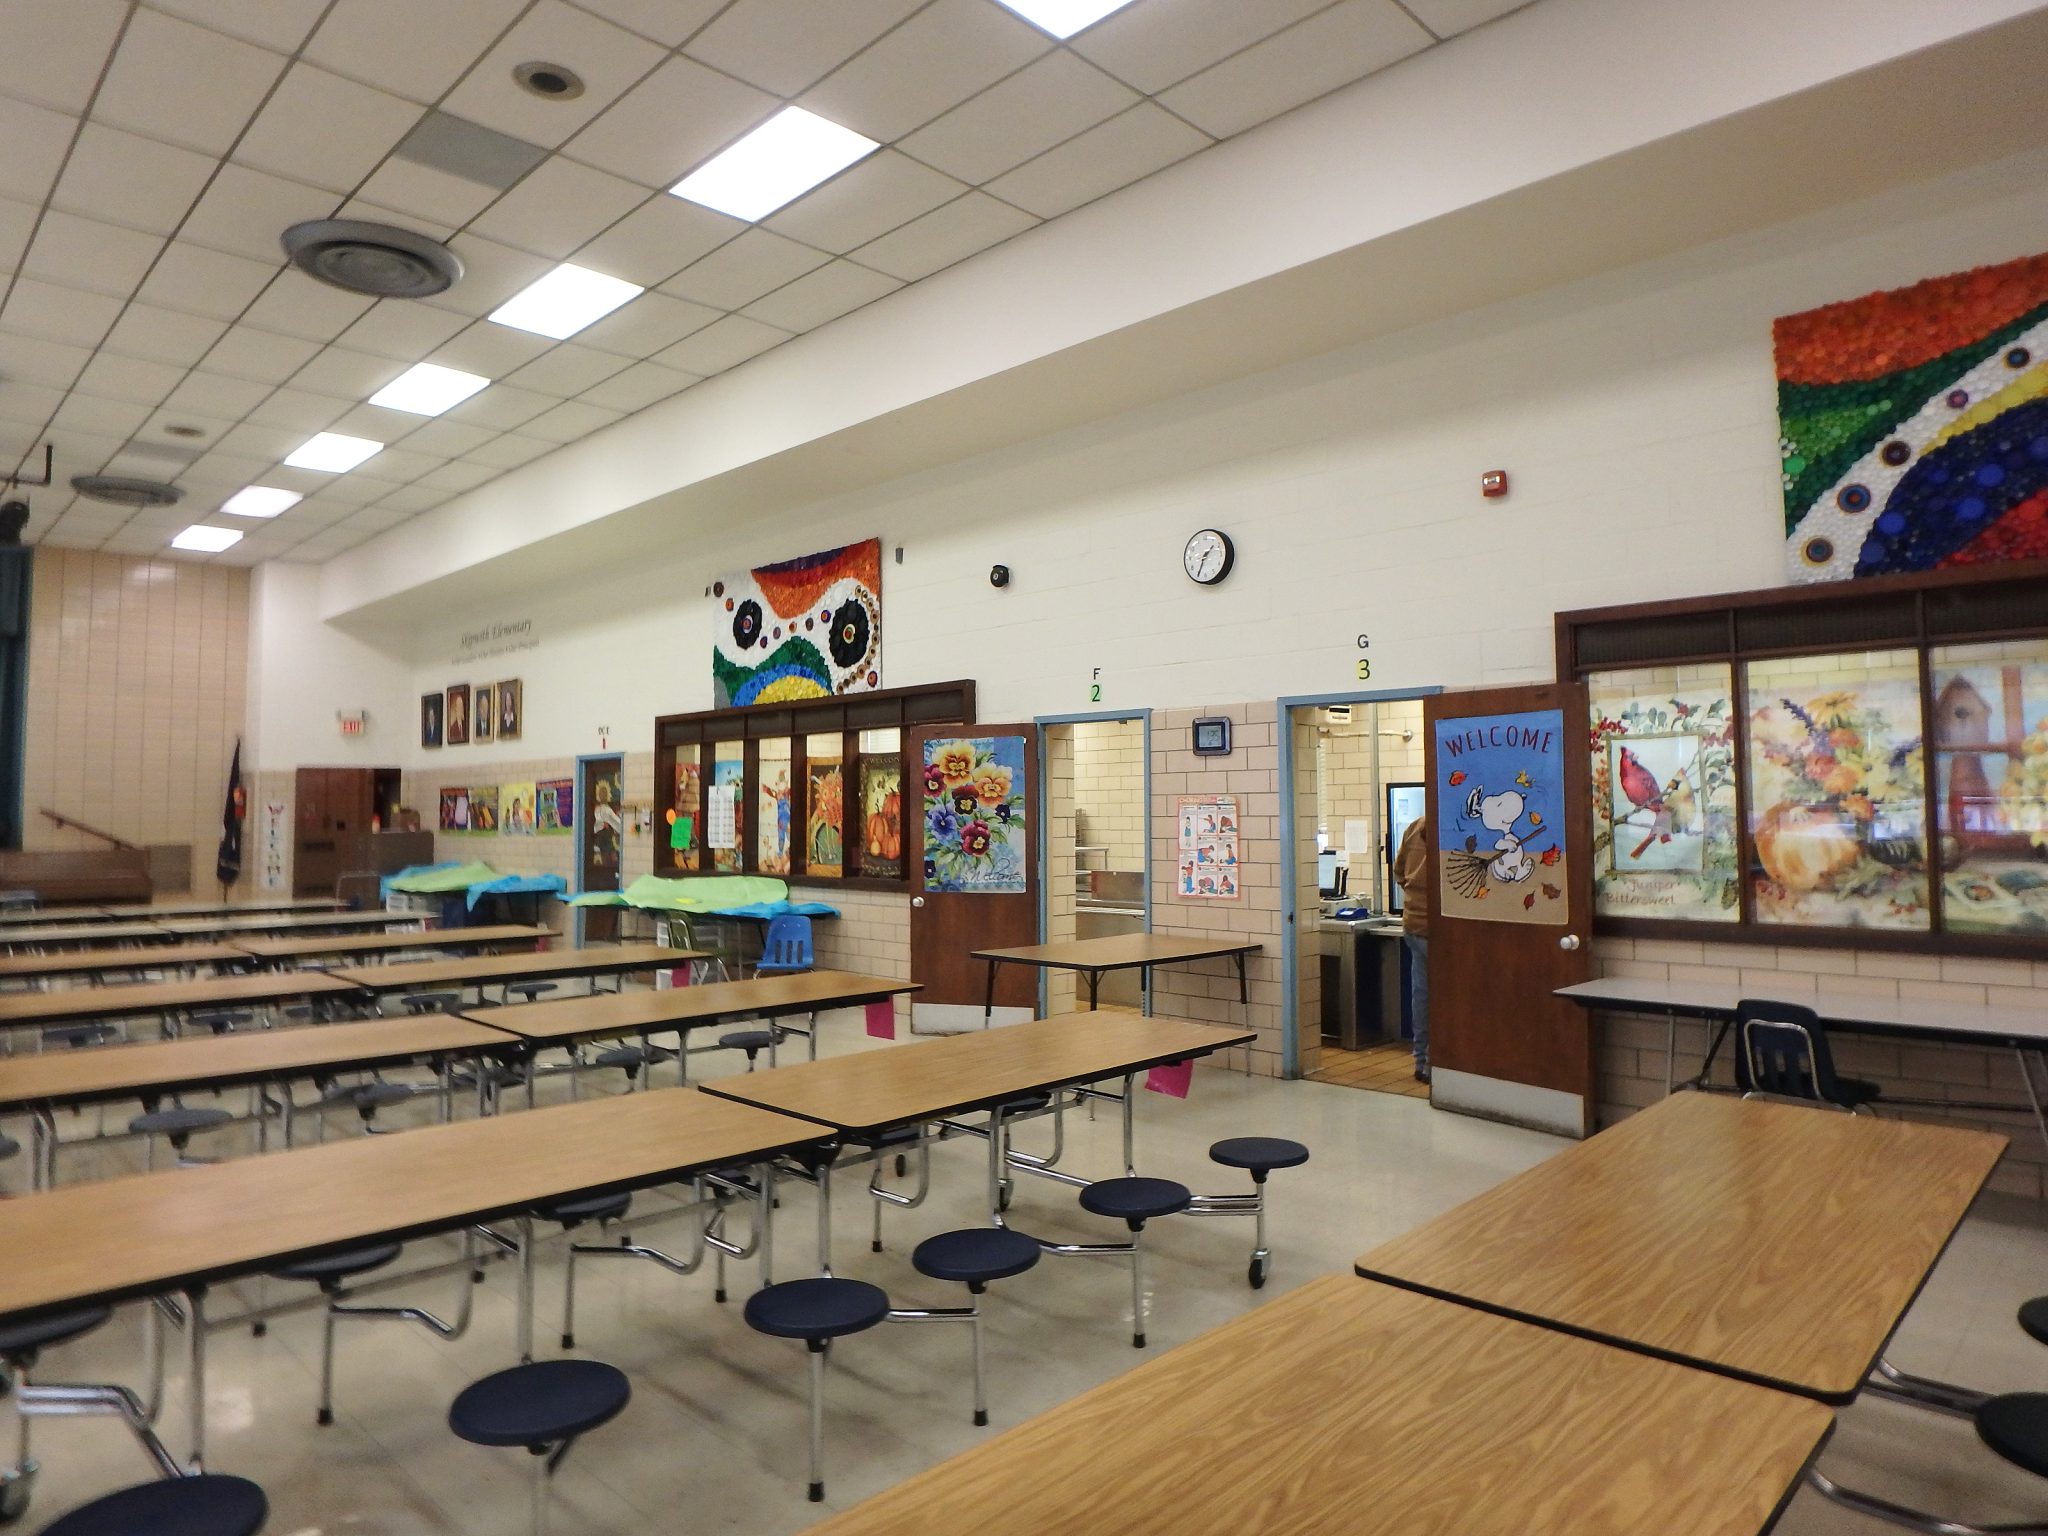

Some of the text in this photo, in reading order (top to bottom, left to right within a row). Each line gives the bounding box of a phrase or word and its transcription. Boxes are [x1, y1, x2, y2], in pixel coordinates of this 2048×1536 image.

[1357, 634, 1370, 649] G
[1093, 667, 1101, 681] F
[1358, 658, 1371, 680] 3
[1091, 684, 1101, 703] 2
[343, 719, 361, 733] EXIT
[1445, 725, 1553, 758] WELCOME
[1604, 891, 1676, 905] Bittersweet
